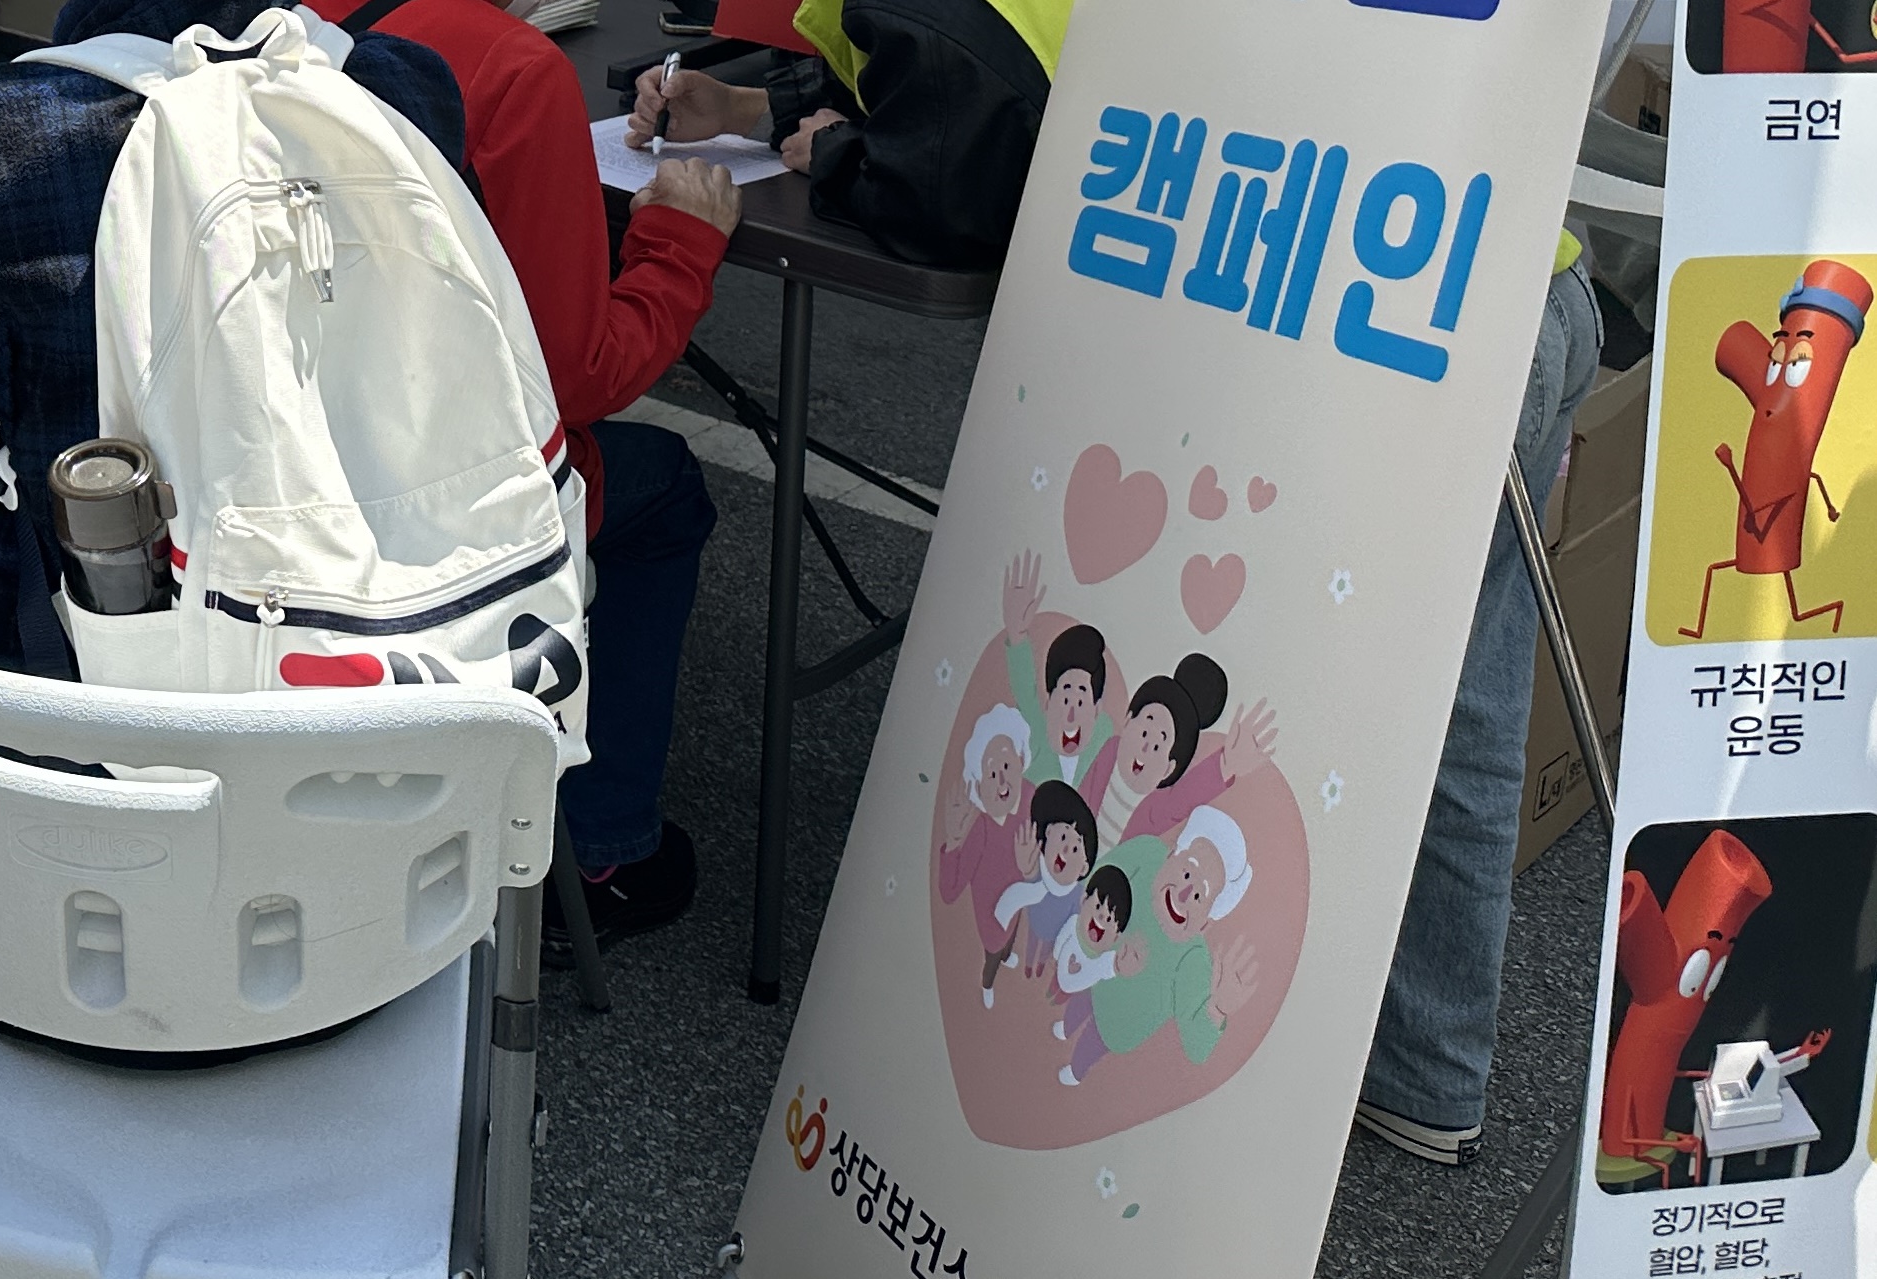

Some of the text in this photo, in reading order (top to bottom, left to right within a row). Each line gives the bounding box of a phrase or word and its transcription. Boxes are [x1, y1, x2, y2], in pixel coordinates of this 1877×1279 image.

[1765, 99, 1842, 141] 금연
[1067, 105, 1492, 384] 캠페인
[1690, 660, 1847, 708] 규칙적인
[1726, 713, 1804, 757] 운동
[1652, 1197, 1786, 1237] 정기적으로
[1649, 1237, 1771, 1278] 혈압, 혈당,
